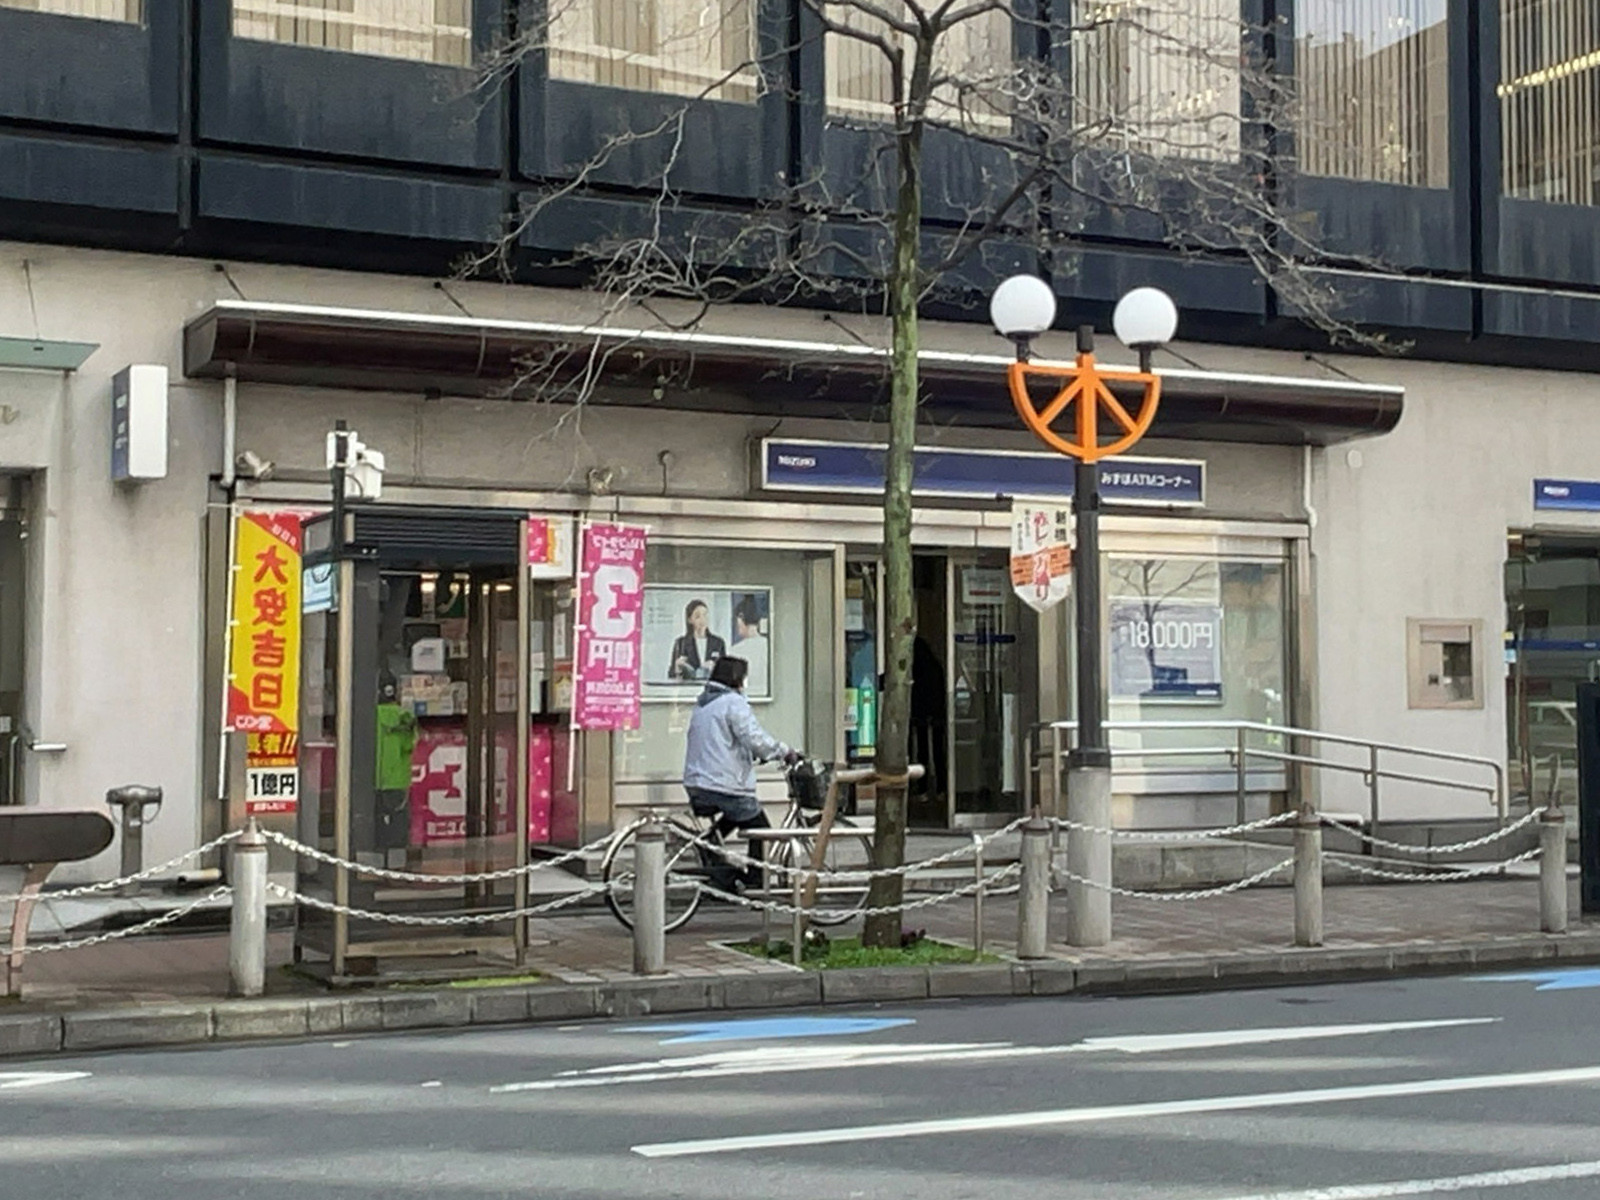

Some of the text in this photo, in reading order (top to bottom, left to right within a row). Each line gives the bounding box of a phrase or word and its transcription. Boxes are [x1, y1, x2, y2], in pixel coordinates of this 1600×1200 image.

[1101, 472, 1192, 488] みずほATMコーナー
